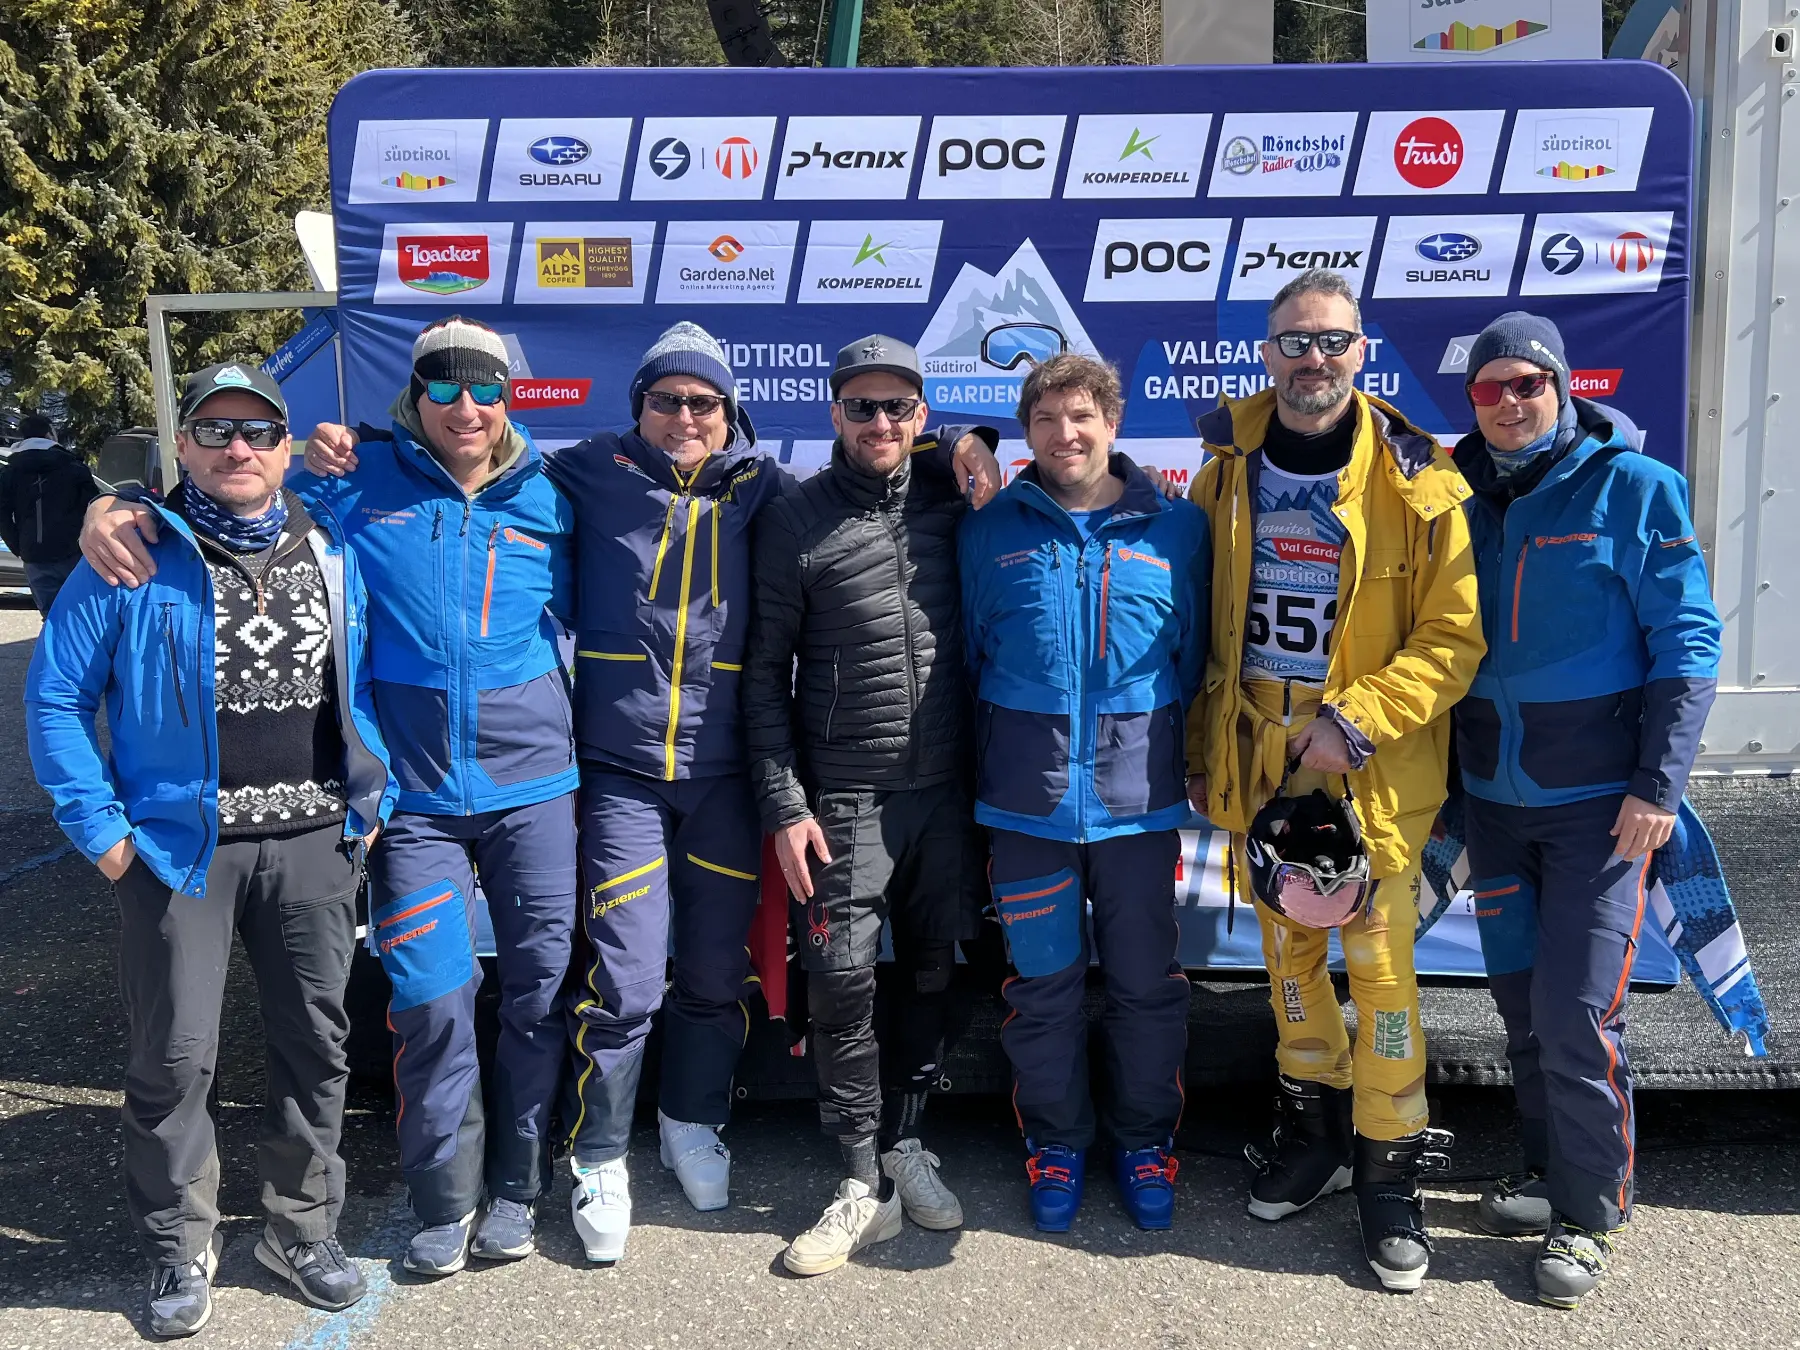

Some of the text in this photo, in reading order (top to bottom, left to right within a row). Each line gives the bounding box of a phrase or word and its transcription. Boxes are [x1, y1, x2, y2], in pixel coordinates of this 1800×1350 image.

[1262, 134, 1345, 153] Mönchshof
[786, 142, 908, 177] phenix
[1262, 156, 1294, 174] Radler
[519, 173, 602, 187] SUBARU
[1082, 171, 1190, 184] KOMPERDELL
[405, 244, 481, 266] Loacker
[588, 246, 628, 255] HIGHEST
[588, 255, 628, 264] QUALITY
[1240, 243, 1363, 278] phenix
[542, 263, 581, 276] ALPS
[679, 267, 775, 282] Gardena.Net
[1405, 269, 1491, 283] SUBARU
[546, 276, 577, 284] COFFEE
[706, 283, 745, 292] Marketing
[746, 283, 775, 292] Agency
[817, 277, 923, 290] KOMPERDELL
[716, 338, 831, 367] ÜDTIROL
[261, 350, 295, 380] Marlene
[924, 361, 977, 374] Südtirol
[1569, 376, 1610, 392] dena
[515, 385, 580, 400] Gardena
[935, 385, 1021, 404] GARDEN
[1280, 543, 1341, 560] Val Garde
[606, 884, 651, 910] ziener
[1013, 904, 1057, 921] ziener
[390, 918, 439, 947] ziener
